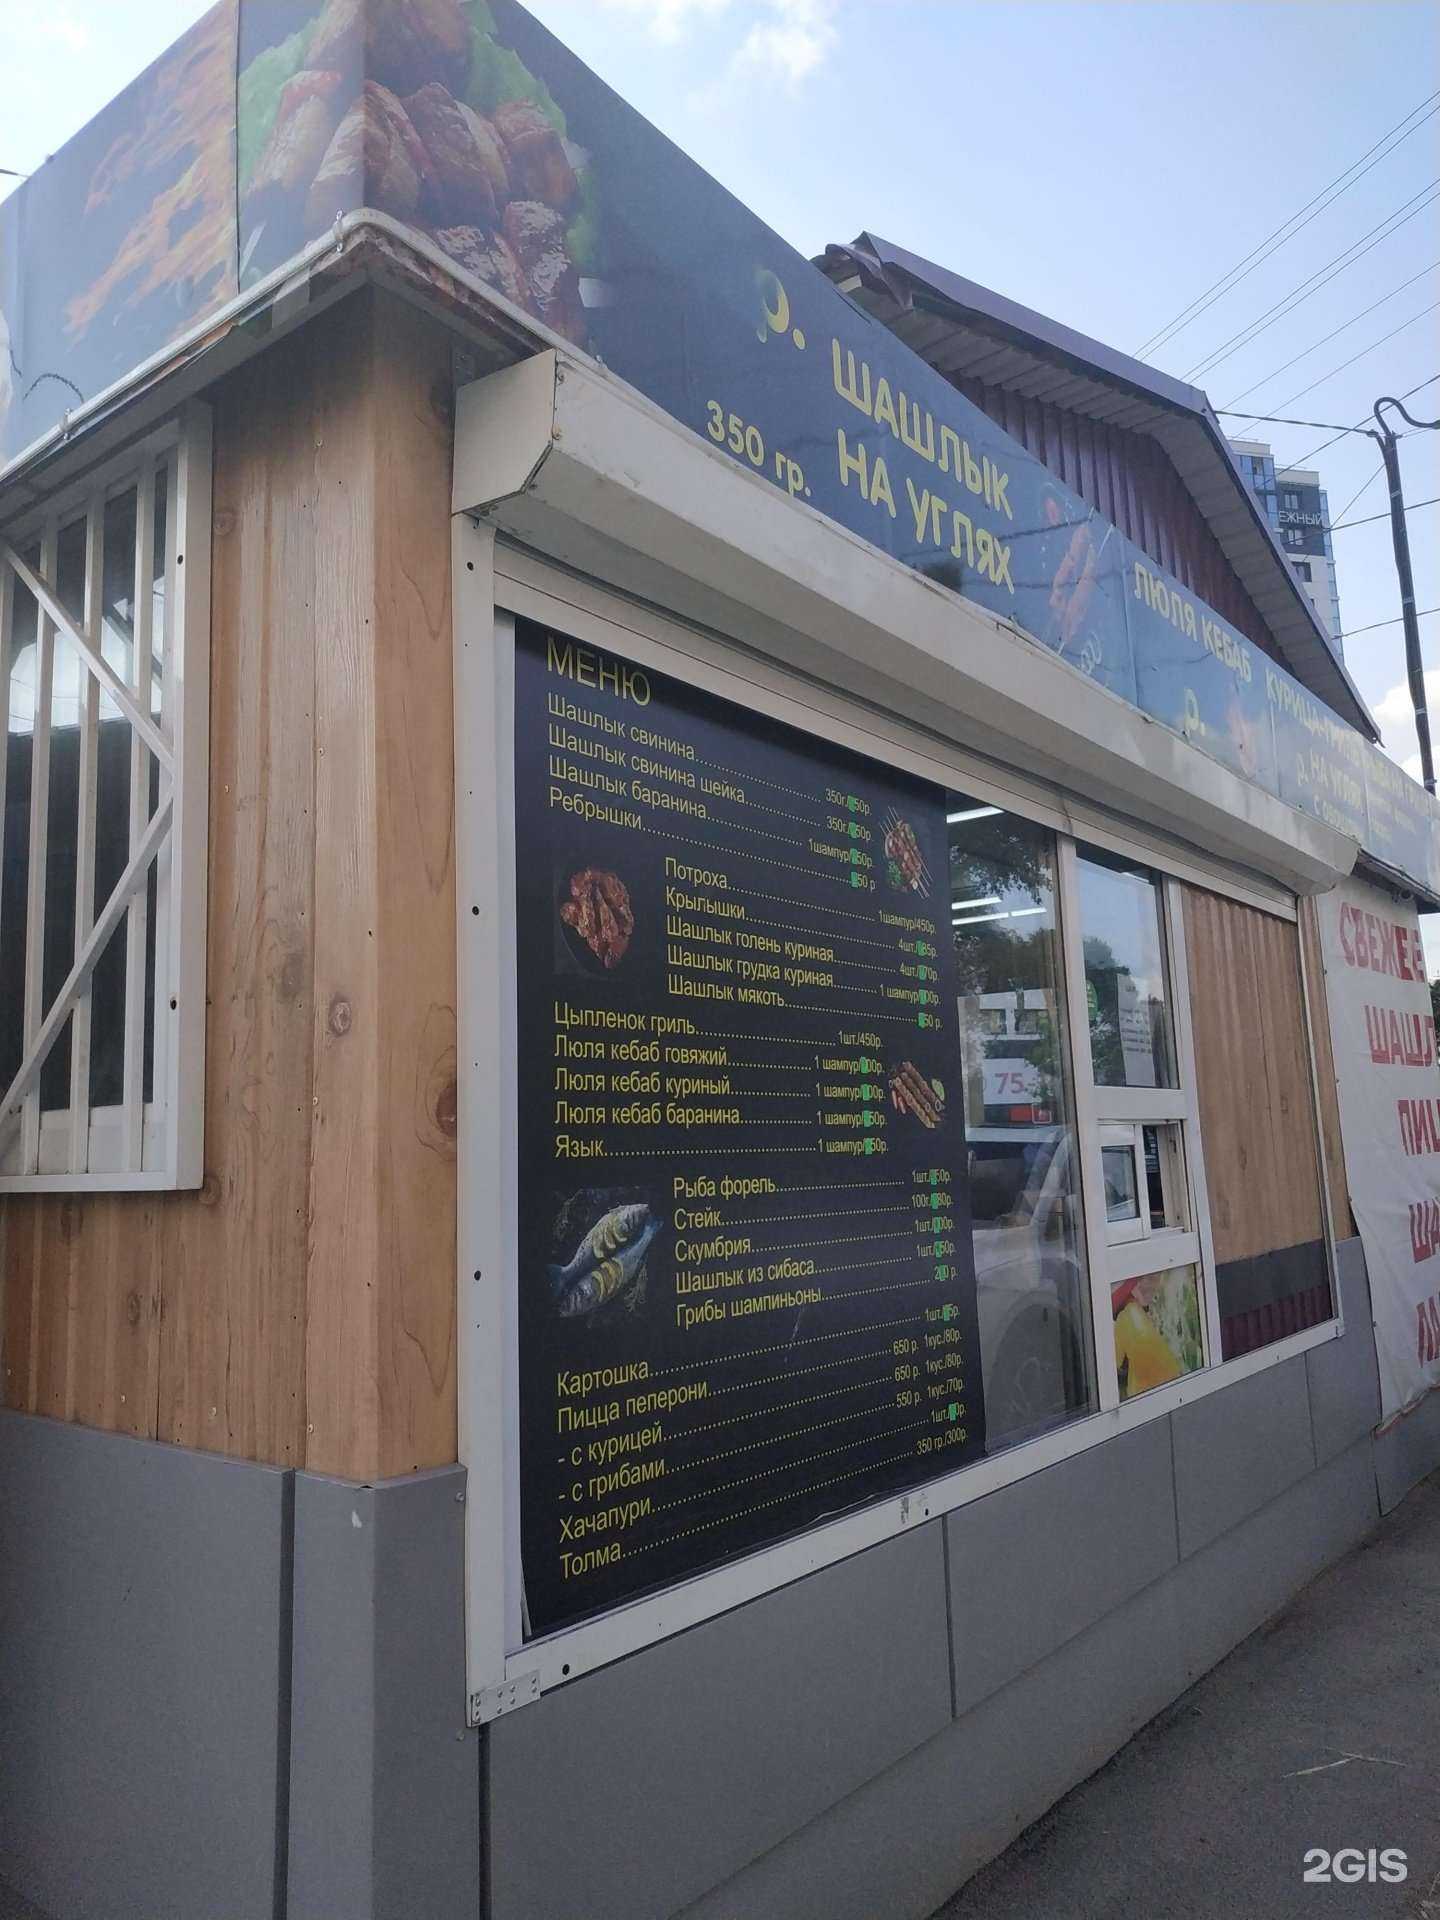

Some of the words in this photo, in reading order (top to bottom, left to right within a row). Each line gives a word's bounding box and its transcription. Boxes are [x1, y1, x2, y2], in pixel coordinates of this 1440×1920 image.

[706, 400, 764, 466] 350
[775, 451, 811, 498] гр.
[832, 338, 1013, 521] ШАШЛЫК
[837, 428, 897, 519] НА
[906, 477, 1015, 595] УГЛЯХ
[1134, 561, 1198, 642] ЛЮЛЯ
[1201, 615, 1252, 683] КЕБАБ
[546, 637, 650, 705] МЕНЮ
[548, 692, 626, 738] Шашлык
[630, 726, 695, 761] свинина
[549, 723, 627, 768] Шашлык
[631, 755, 695, 788] свинина
[700, 775, 745, 804] шейка
[549, 754, 627, 797] Шашлык
[631, 780, 707, 819] баранина
[550, 786, 642, 830] Ребрышки
[665, 857, 728, 889] Потроха
[666, 886, 745, 920] Крылышки
[667, 915, 732, 945] Шашлык
[736, 931, 781, 953] голень
[785, 941, 834, 962] куриная
[668, 943, 733, 973] Шашлык
[737, 960, 780, 981] грудка
[784, 967, 834, 987] куриная
[668, 974, 734, 1001] Шашлык
[738, 987, 785, 1007] мякоть
[554, 1001, 646, 1030] Цыпленок
[651, 1014, 696, 1037] гриль
[554, 1035, 605, 1058] Люля
[611, 1040, 660, 1063] кебаб
[665, 1046, 728, 1066] говяжий
[555, 1068, 605, 1091] Люля
[611, 1071, 660, 1093] кебаб
[665, 1075, 730, 1098] куриный
[555, 1101, 606, 1124] Люля
[612, 1102, 661, 1125] кебаб
[666, 1103, 740, 1128] баранина
[555, 1135, 604, 1157] Язык
[673, 1175, 716, 1199] Рыба
[720, 1175, 777, 1200] форель
[674, 1206, 721, 1230] Стейк
[675, 1236, 752, 1265] Скумбрия
[676, 1270, 744, 1294] Шашлык
[748, 1266, 763, 1283] из
[767, 1257, 816, 1281] сибаса
[676, 1299, 726, 1330] Грибы
[731, 1287, 822, 1317] шампиньоны
[557, 1361, 649, 1398] Картошка
[558, 1401, 620, 1432] Пицца
[626, 1381, 708, 1416] пеперони
[893, 1338, 908, 1356] 650
[571, 1447, 583, 1466] с
[588, 1421, 663, 1466] курицей
[894, 1364, 910, 1382] 650
[572, 1483, 583, 1502] с
[589, 1458, 665, 1501] грибами
[559, 1497, 651, 1543] Хачапури
[560, 1542, 621, 1579] Толма
[916, 1437, 932, 1456] 350
